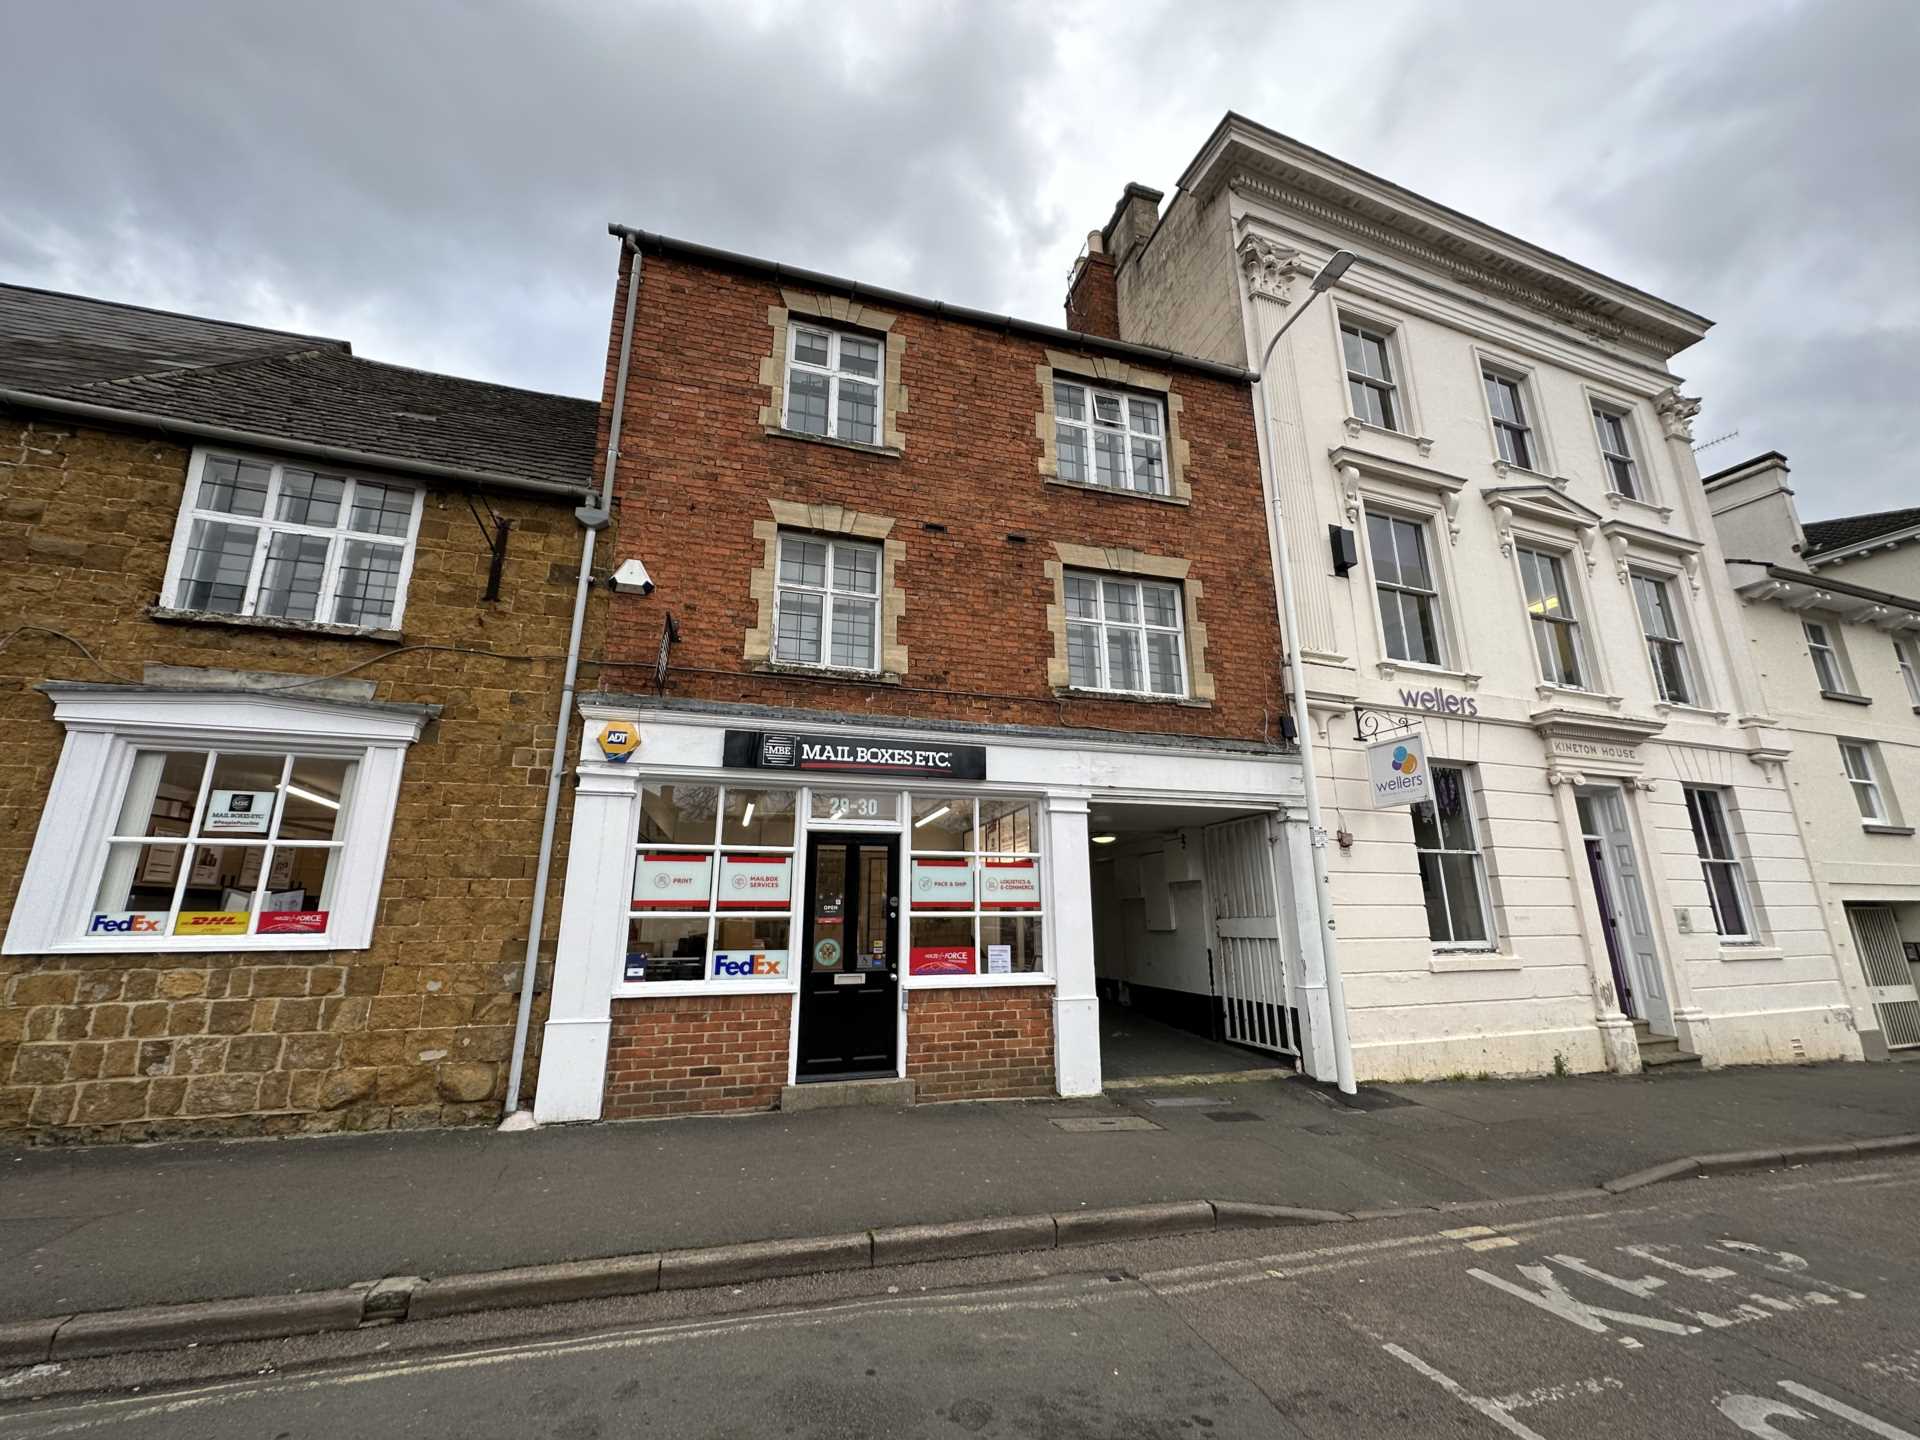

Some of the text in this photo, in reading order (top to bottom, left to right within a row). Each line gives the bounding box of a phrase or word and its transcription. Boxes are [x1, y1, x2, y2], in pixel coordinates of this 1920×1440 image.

[1398, 686, 1478, 717] wellers
[607, 731, 629, 744] ADT
[767, 745, 791, 755] MBE
[801, 743, 854, 762] MAIL
[856, 747, 913, 765] BOXES
[1553, 742, 1636, 759] KINETON HOUSE
[1375, 774, 1423, 792] wellers
[831, 797, 878, 817] 29-30
[92, 914, 161, 932] FedEx
[191, 916, 236, 925] DHL
[714, 953, 781, 976] FedEx
